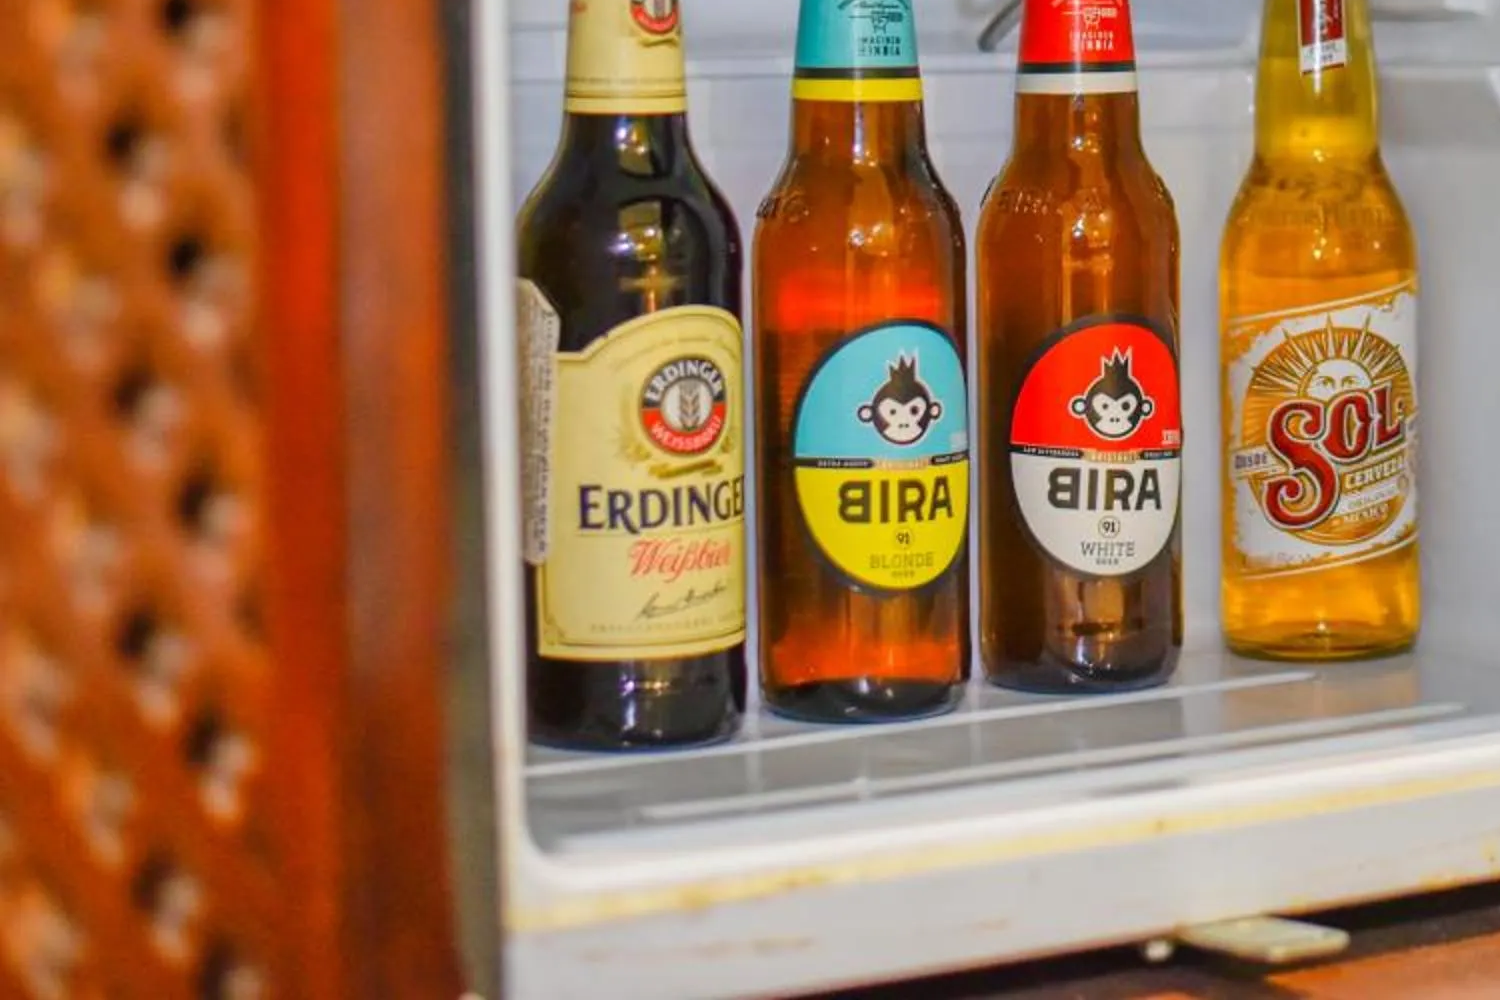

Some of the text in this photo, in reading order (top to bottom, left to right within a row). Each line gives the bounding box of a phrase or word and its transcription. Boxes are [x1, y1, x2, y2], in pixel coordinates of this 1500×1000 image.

[1262, 380, 1406, 530] SOL
[838, 475, 953, 524] BIRA
[1048, 468, 1162, 510] BIRA
[869, 552, 935, 569] BLONDE
[1081, 541, 1136, 557] WHITE
